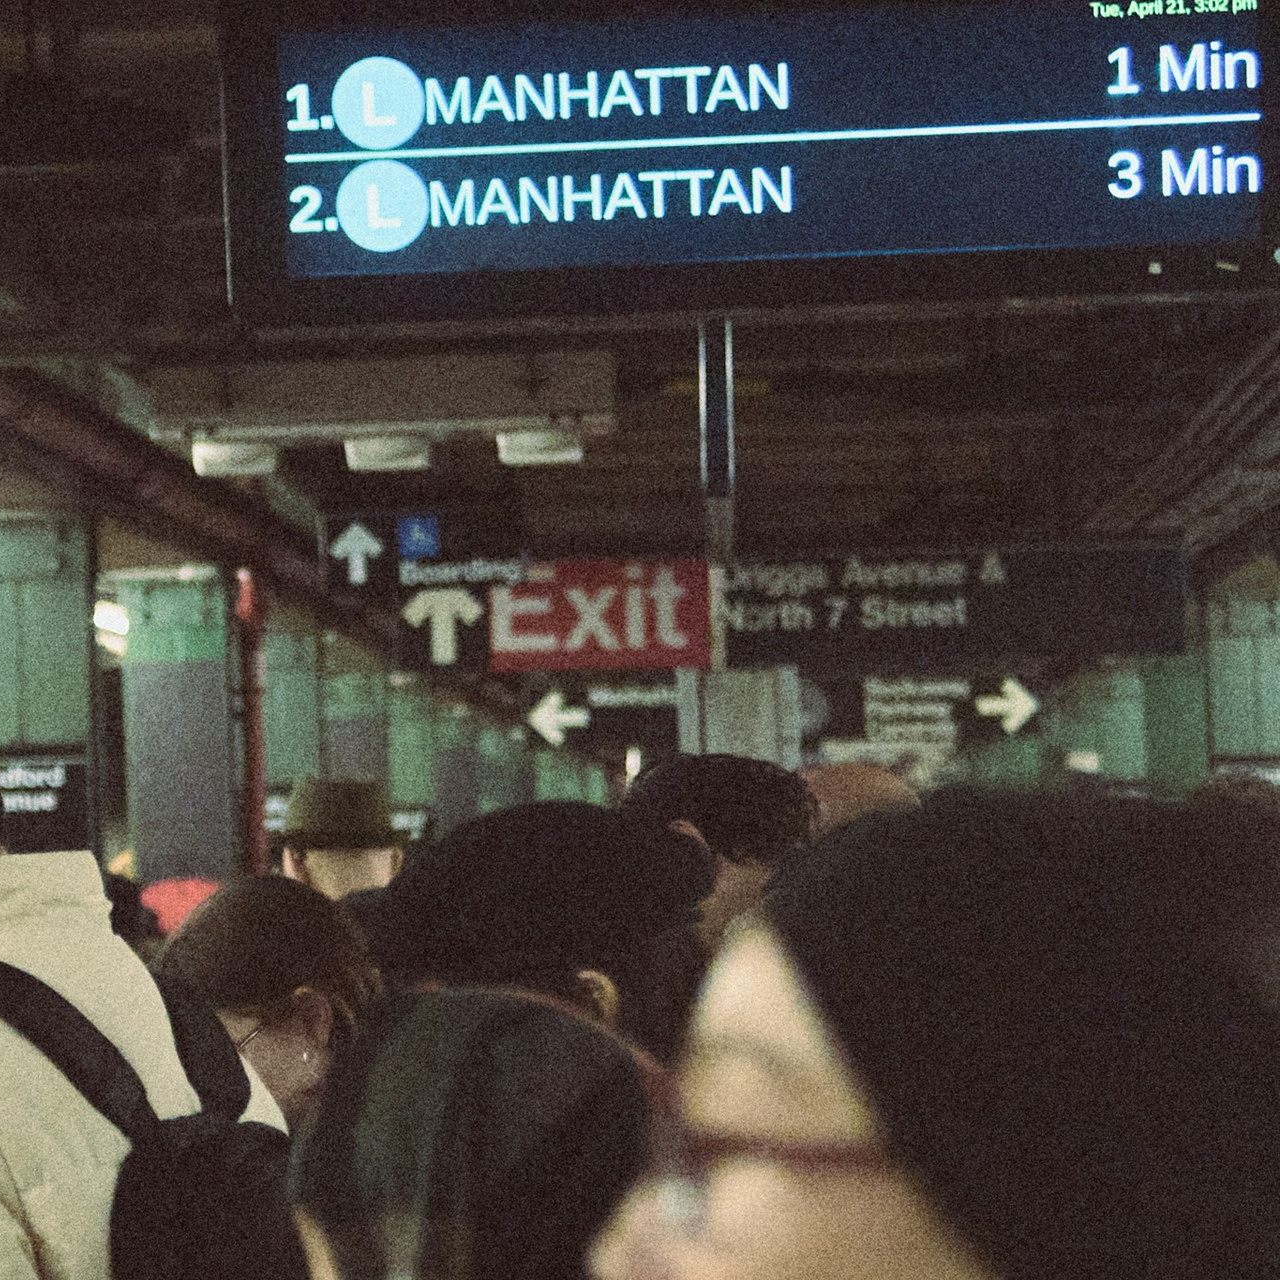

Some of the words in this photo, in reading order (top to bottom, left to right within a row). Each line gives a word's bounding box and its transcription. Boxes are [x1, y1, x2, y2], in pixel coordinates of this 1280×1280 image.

[1089, 1, 1124, 18] Tue,
[1126, 0, 1163, 19] April
[285, 83, 334, 132] 1.
[361, 80, 397, 127] L
[424, 61, 790, 126] MANHATTAN
[1106, 45, 1141, 96] 1
[1158, 39, 1261, 94] Min
[288, 184, 339, 233] 2.
[366, 183, 402, 229] L
[428, 165, 793, 228] MANHATTAN
[1107, 149, 1143, 199] 3
[1160, 144, 1262, 197] Min
[491, 562, 687, 651] Exit
[824, 594, 848, 630] 7
[860, 594, 967, 631] Street
